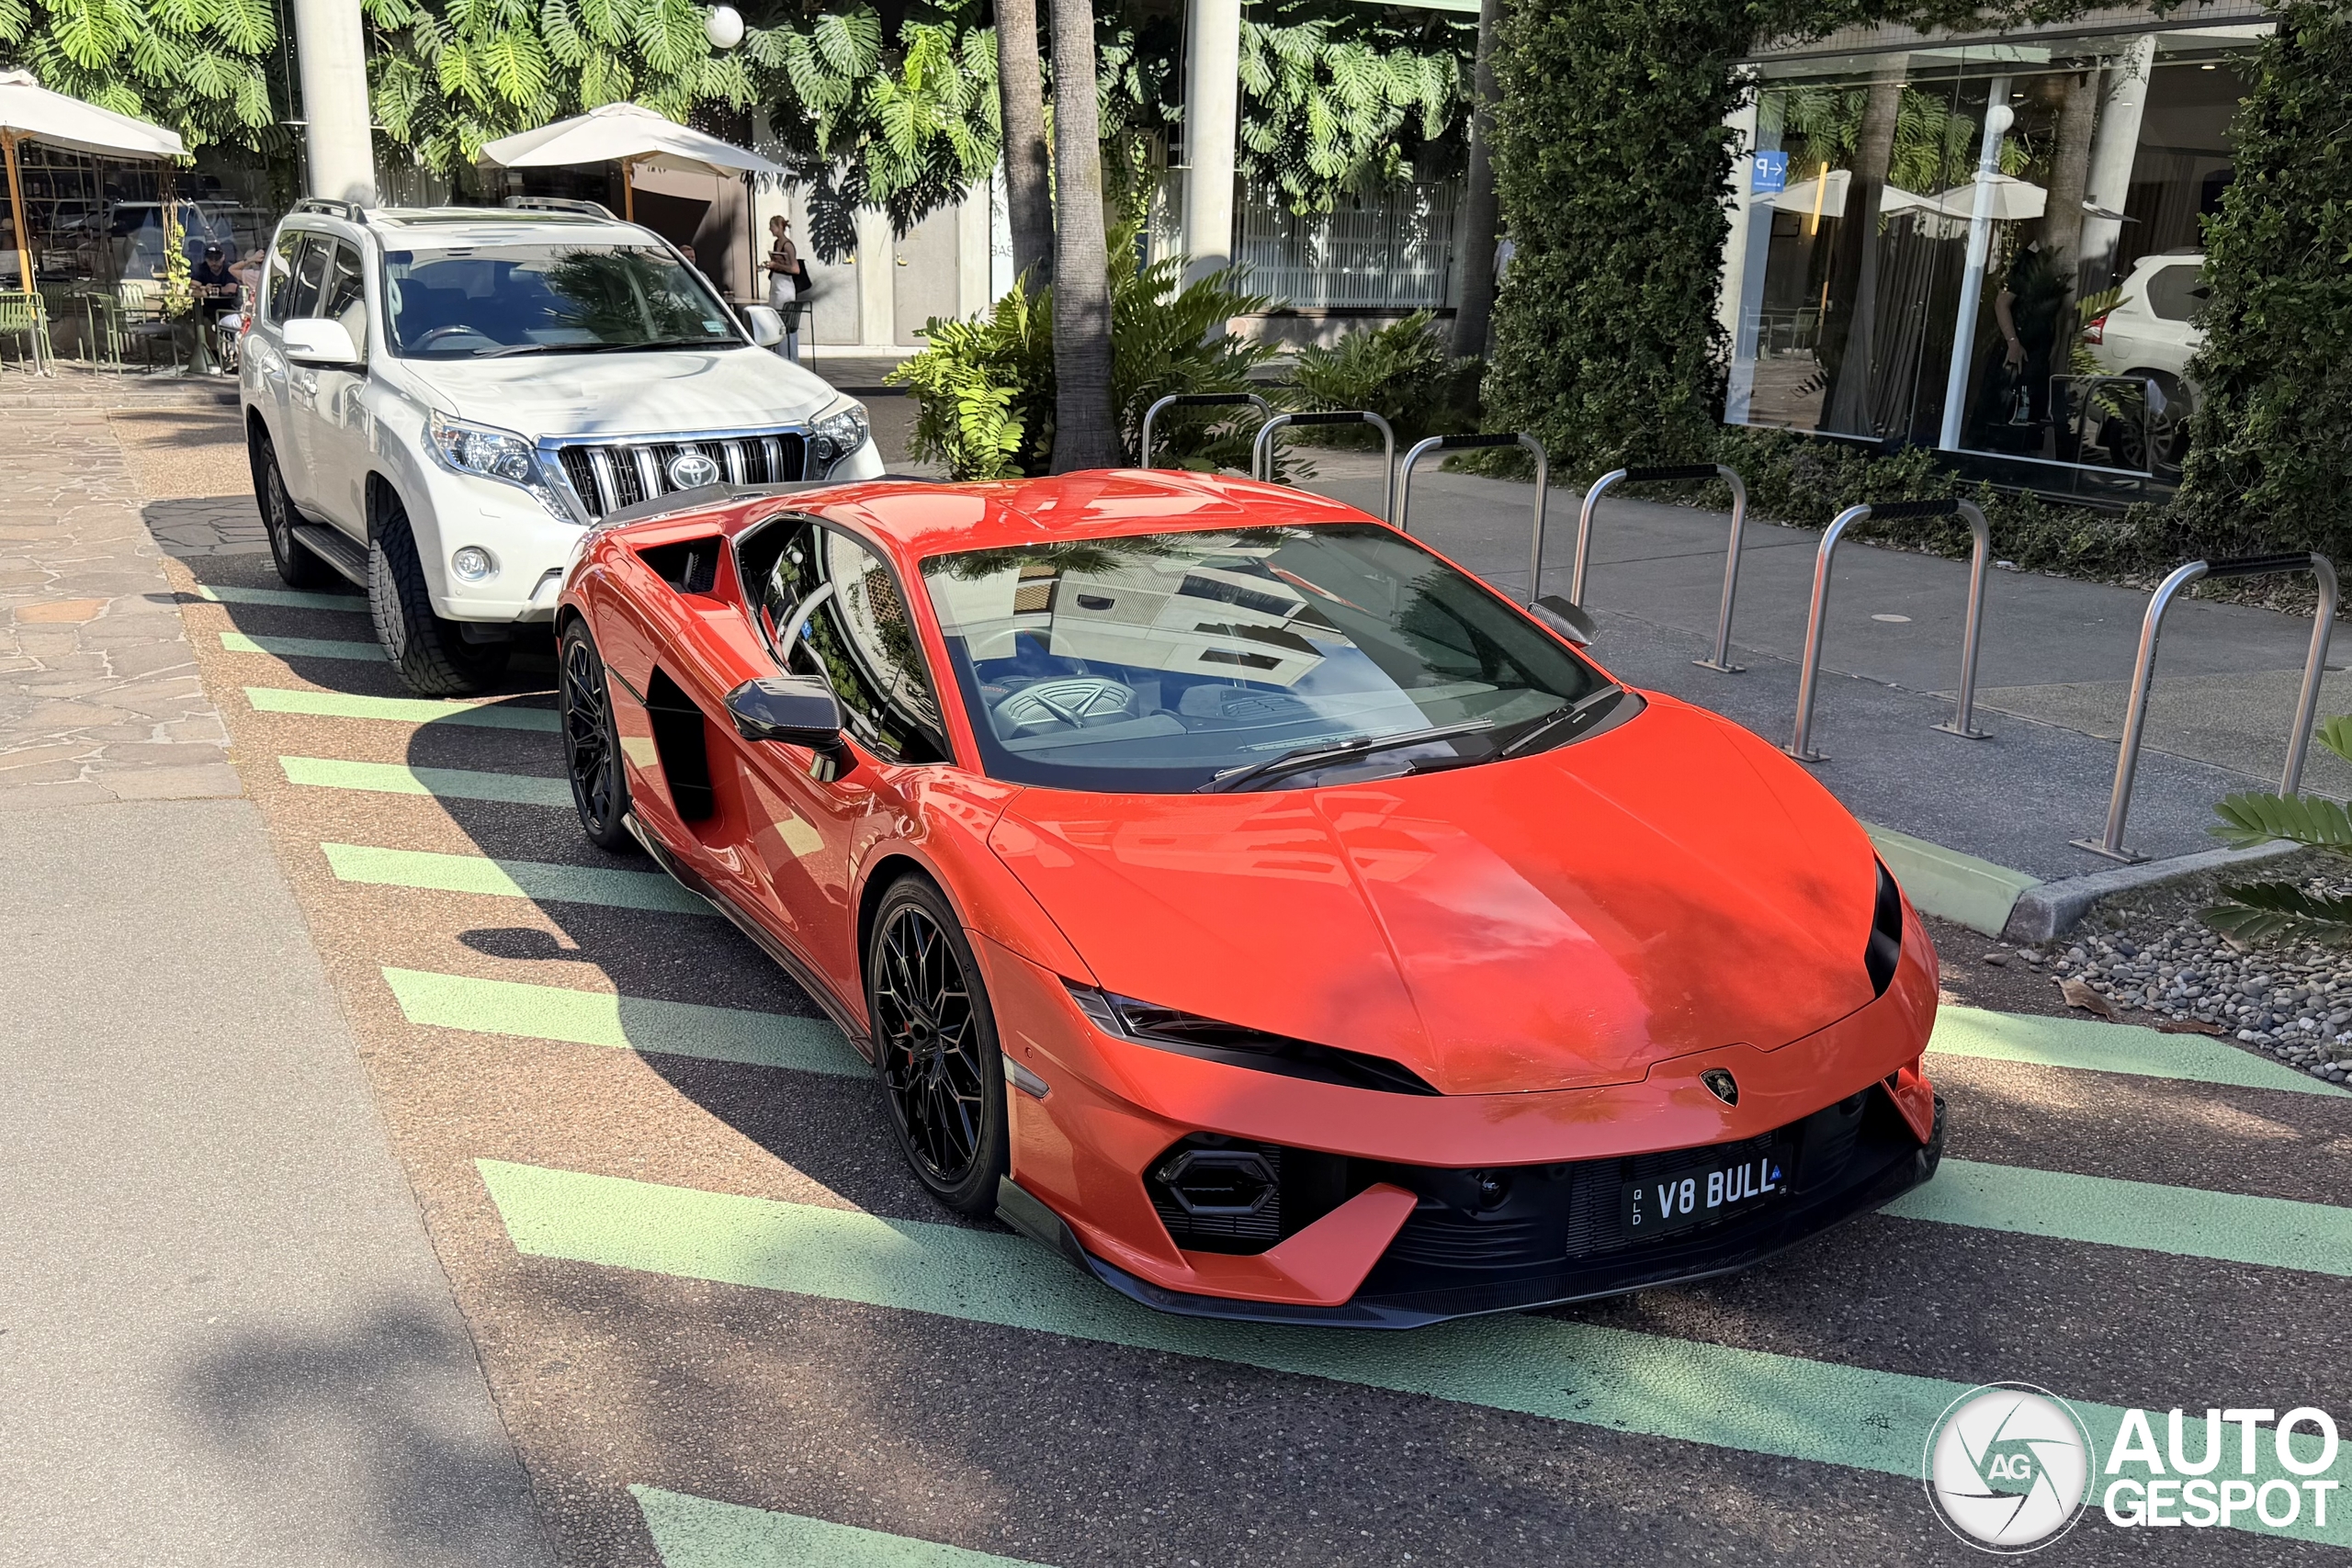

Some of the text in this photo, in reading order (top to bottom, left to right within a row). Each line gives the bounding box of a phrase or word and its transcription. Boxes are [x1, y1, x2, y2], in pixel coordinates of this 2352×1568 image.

[1632, 1189, 1643, 1225] QLD
[1657, 1157, 1776, 1219] V8 BULL
